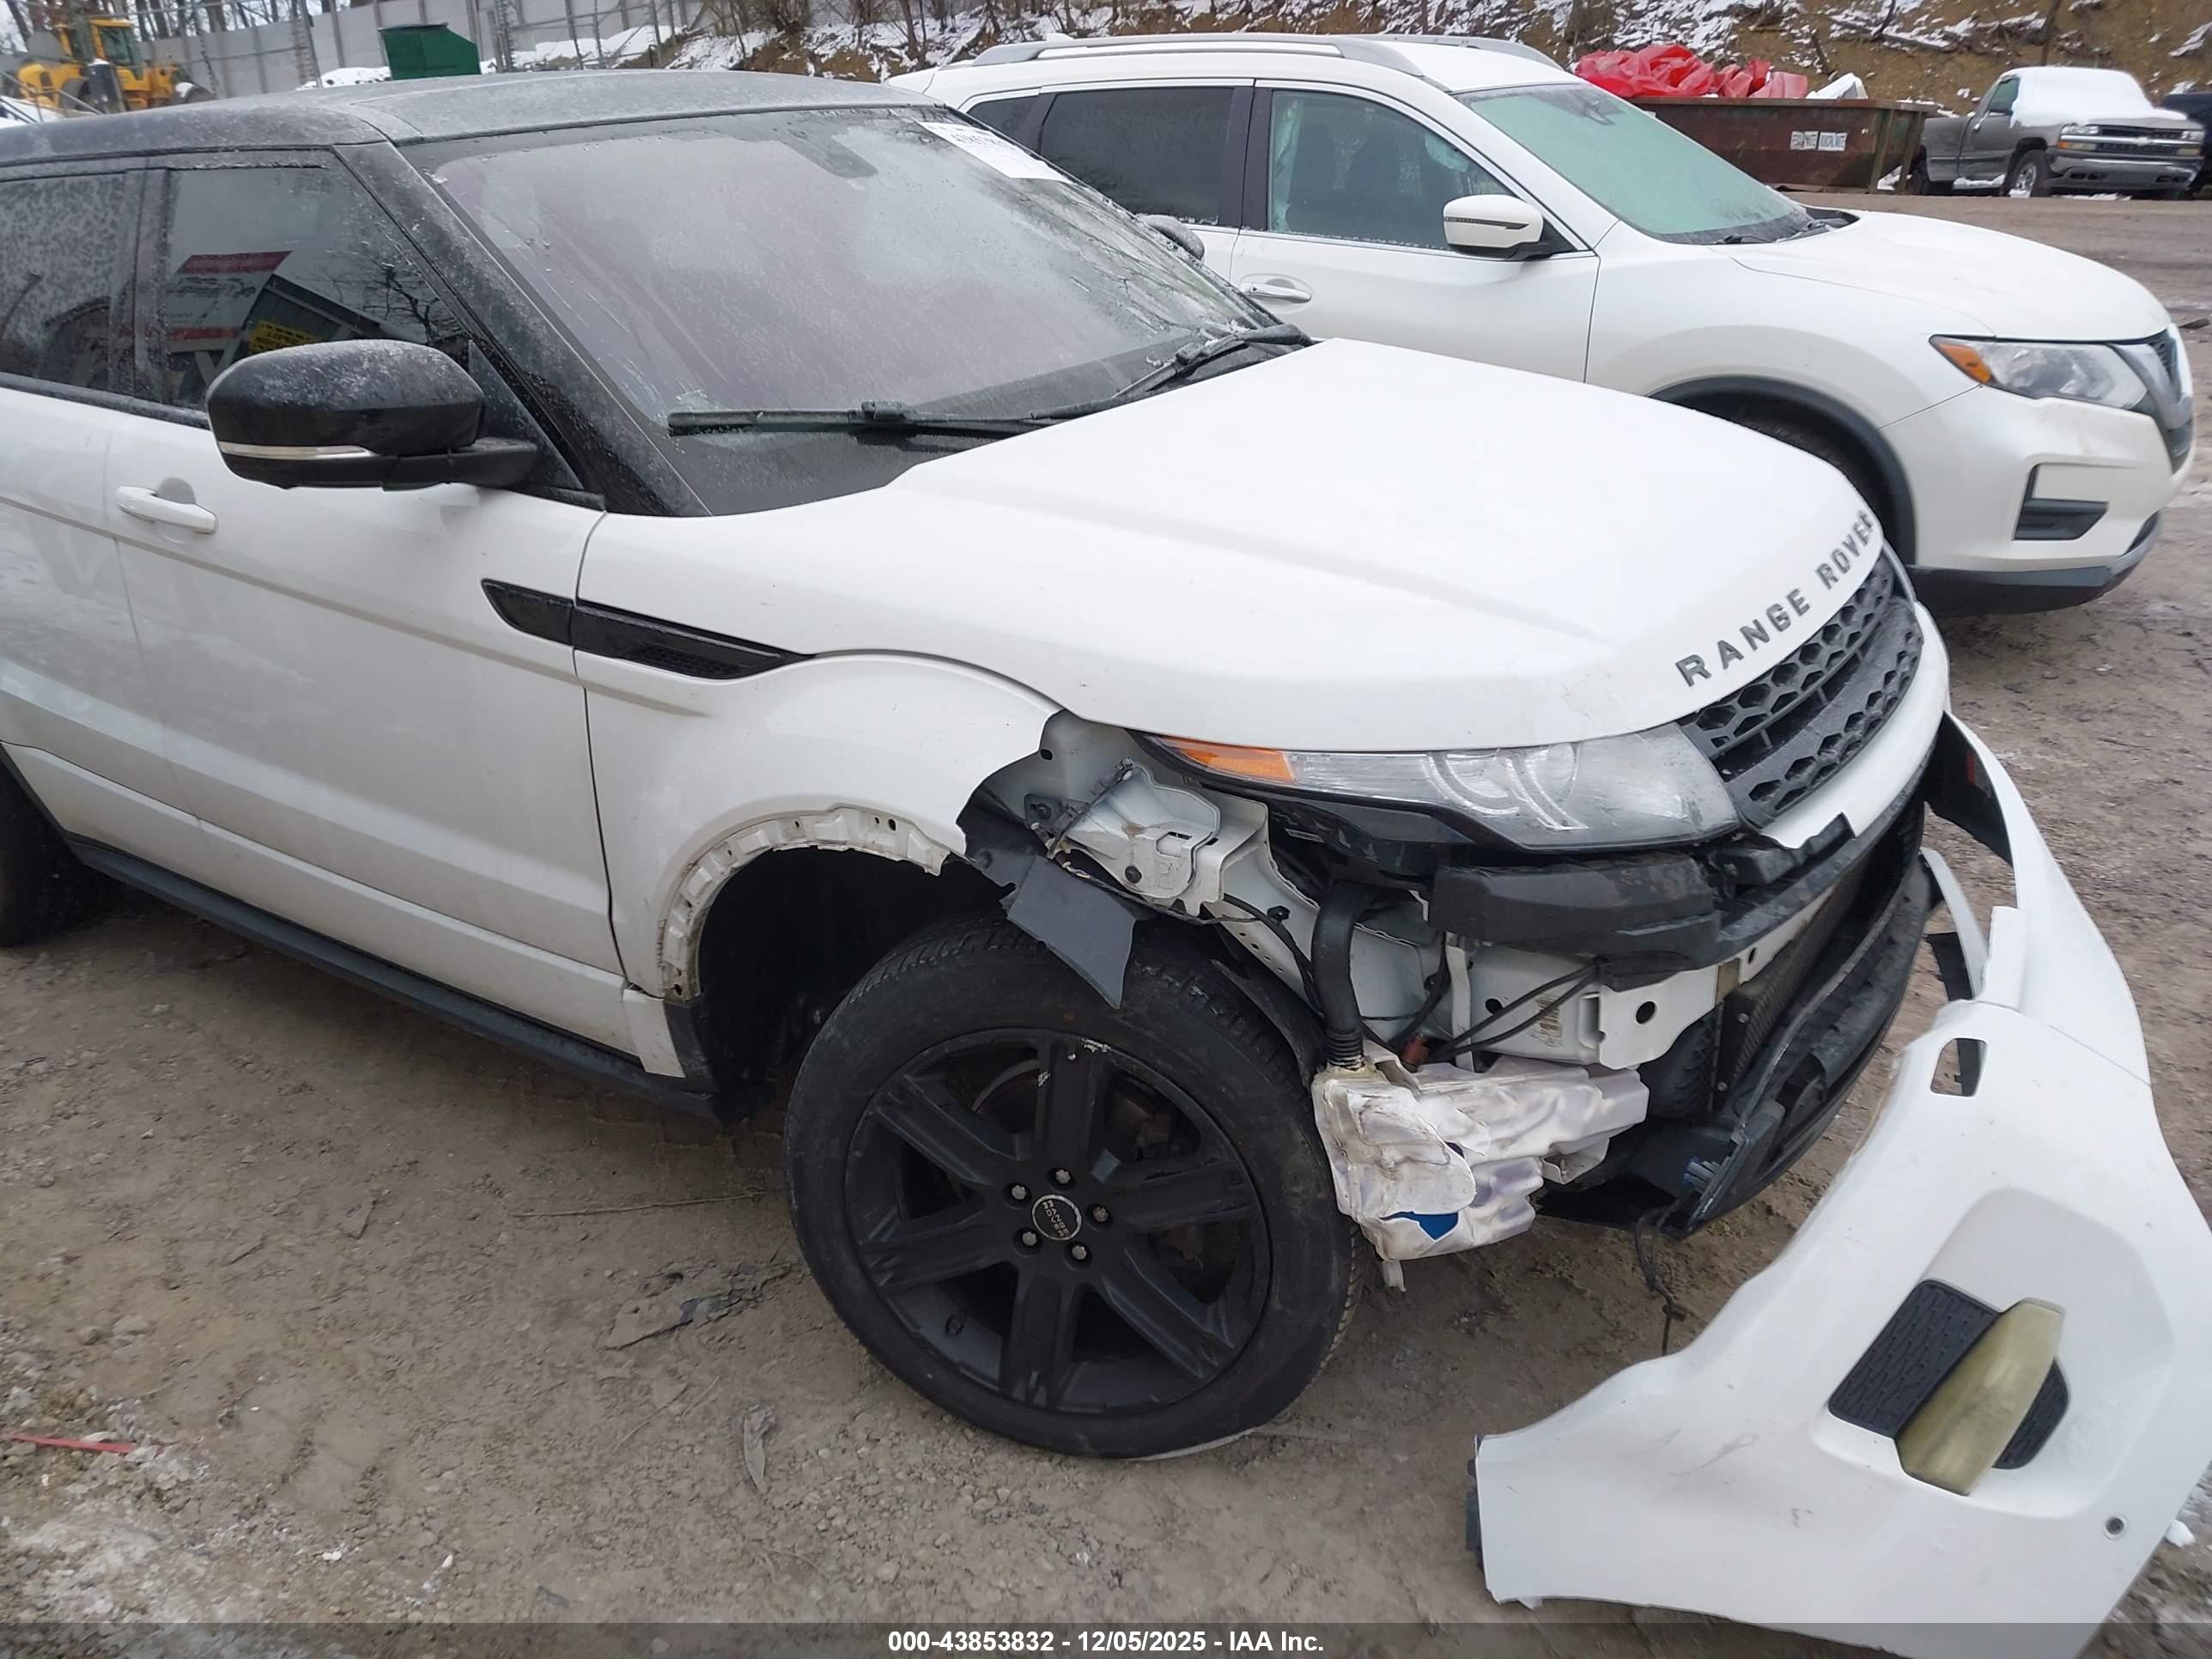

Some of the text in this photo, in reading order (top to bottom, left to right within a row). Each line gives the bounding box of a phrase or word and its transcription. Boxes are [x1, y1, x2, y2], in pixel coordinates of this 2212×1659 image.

[1674, 588, 1811, 687] RANGE
[1042, 1201, 1065, 1237] ROVER
[1047, 1200, 1071, 1237] RANGE
